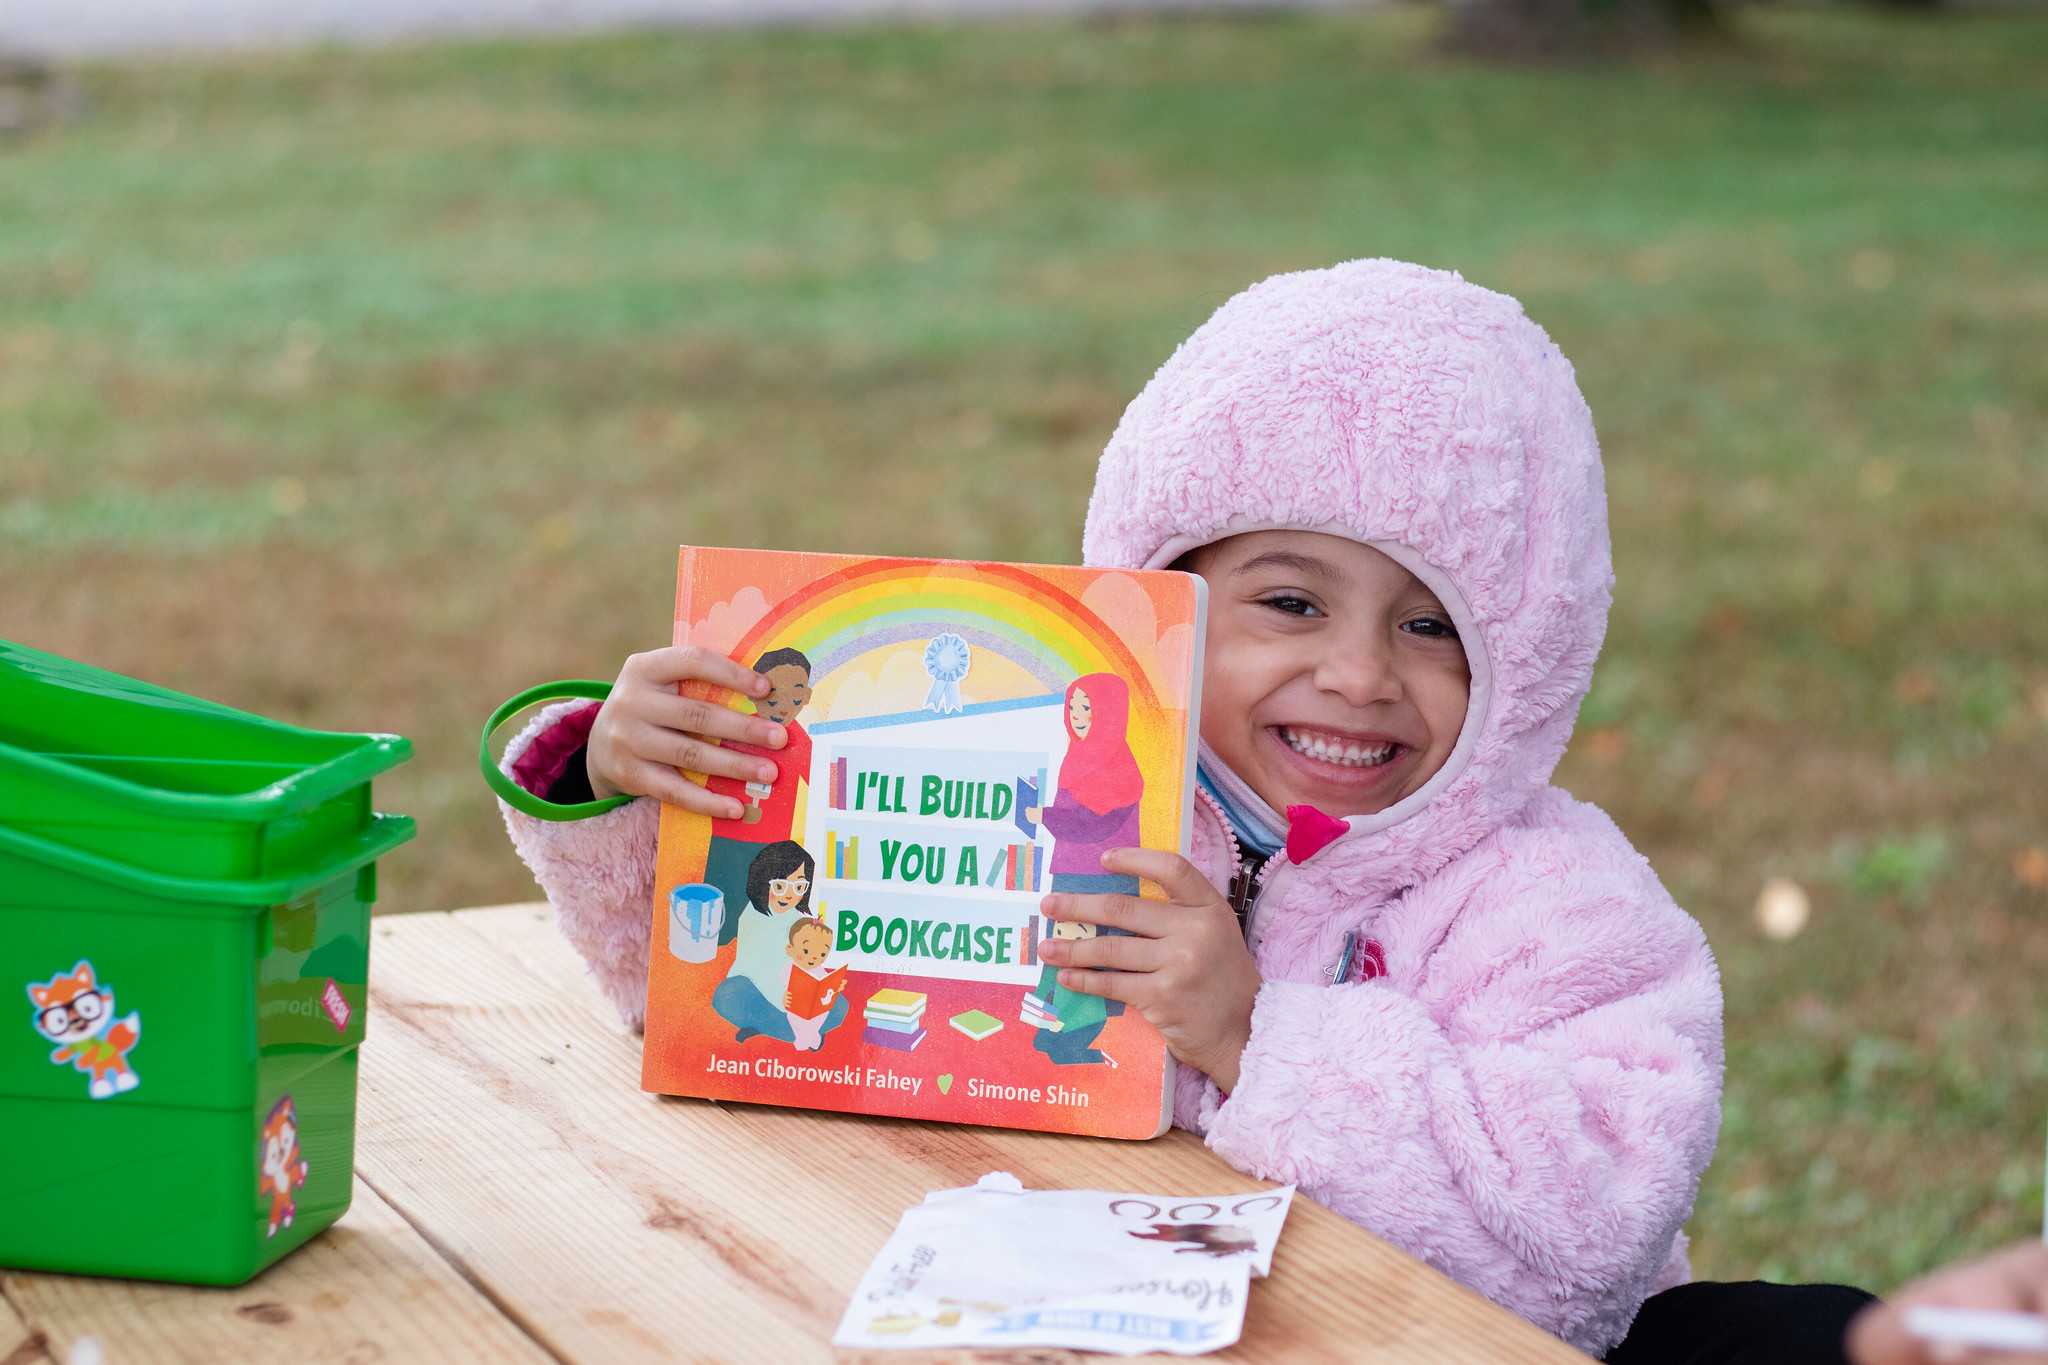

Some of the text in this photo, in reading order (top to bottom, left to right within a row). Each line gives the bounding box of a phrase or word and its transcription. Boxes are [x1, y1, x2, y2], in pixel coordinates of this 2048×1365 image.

[855, 771, 1013, 821] I'LL BUILD
[879, 839, 979, 886] YOU A
[835, 909, 1013, 964] BOOKCASE
[706, 1054, 923, 1096] Jean Ciborowski Fahey
[967, 1077, 1089, 1108] Simone Shin
